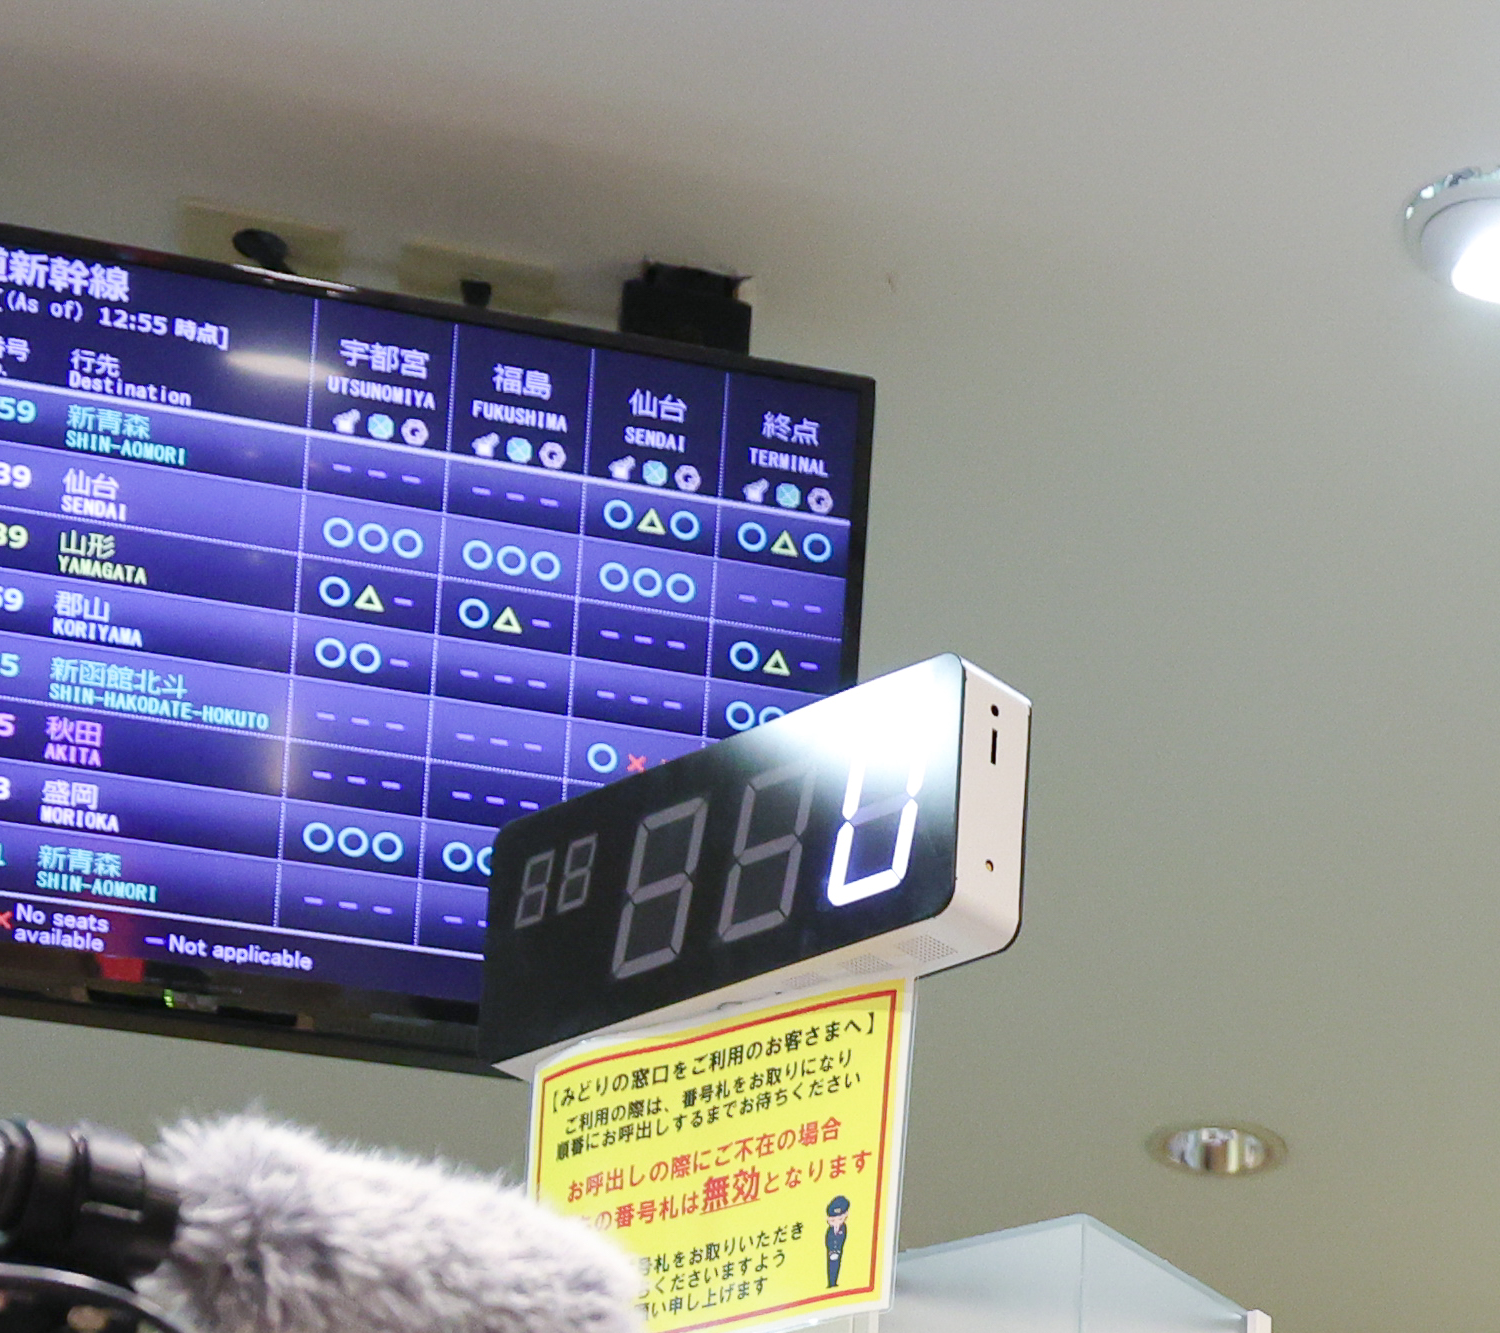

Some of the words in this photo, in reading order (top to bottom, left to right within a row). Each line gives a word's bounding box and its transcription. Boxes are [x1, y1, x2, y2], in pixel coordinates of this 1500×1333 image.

[50, 297, 84, 323] of)
[98, 306, 168, 336] 12:55
[173, 317, 230, 351] 時点]
[70, 349, 121, 378] 行先
[339, 337, 430, 379] 宇都宮
[68, 369, 192, 407] Destination
[327, 375, 436, 411] UTSUNOMIYA
[492, 363, 552, 400] 福島
[66, 403, 151, 440] 新青森
[471, 399, 568, 435] FUKUSHIMA
[628, 388, 688, 424] 仙台
[624, 425, 687, 454] SENDAI
[762, 411, 821, 447] 終点
[65, 429, 187, 467] SHIN-AOMORI
[748, 446, 829, 478] TERMINAL
[62, 468, 120, 499] 仙台
[60, 494, 128, 523] SENDAI
[58, 530, 117, 559] 山形
[57, 554, 148, 586] YAMAGATA
[55, 592, 111, 623] 郡山
[52, 617, 143, 648] KORIYAMA
[50, 656, 188, 701] 新函館北斗
[49, 681, 270, 732] SHIN-HAKODATE-HOKUTO
[46, 716, 103, 748] 秋田
[44, 741, 102, 769] AKITA
[41, 779, 100, 811] 盛岡
[40, 805, 120, 834] MORIOKA
[37, 844, 122, 879] 新青森
[36, 869, 157, 904] SHIN-AOMORI
[16, 903, 53, 926] No
[58, 910, 109, 934] seats
[15, 920, 105, 954] available
[168, 932, 208, 958] Not
[212, 940, 314, 972] applicable
[552, 1011, 876, 1113] 【みどりの窓口をご利用のお客さまへ】
[565, 1049, 853, 1135] ご利用の際は、番号札をお取りになり
[556, 1072, 862, 1161] 順番にお呼出しするまでお待ちください
[567, 1116, 843, 1203] お呼出しの際にご不在の場合
